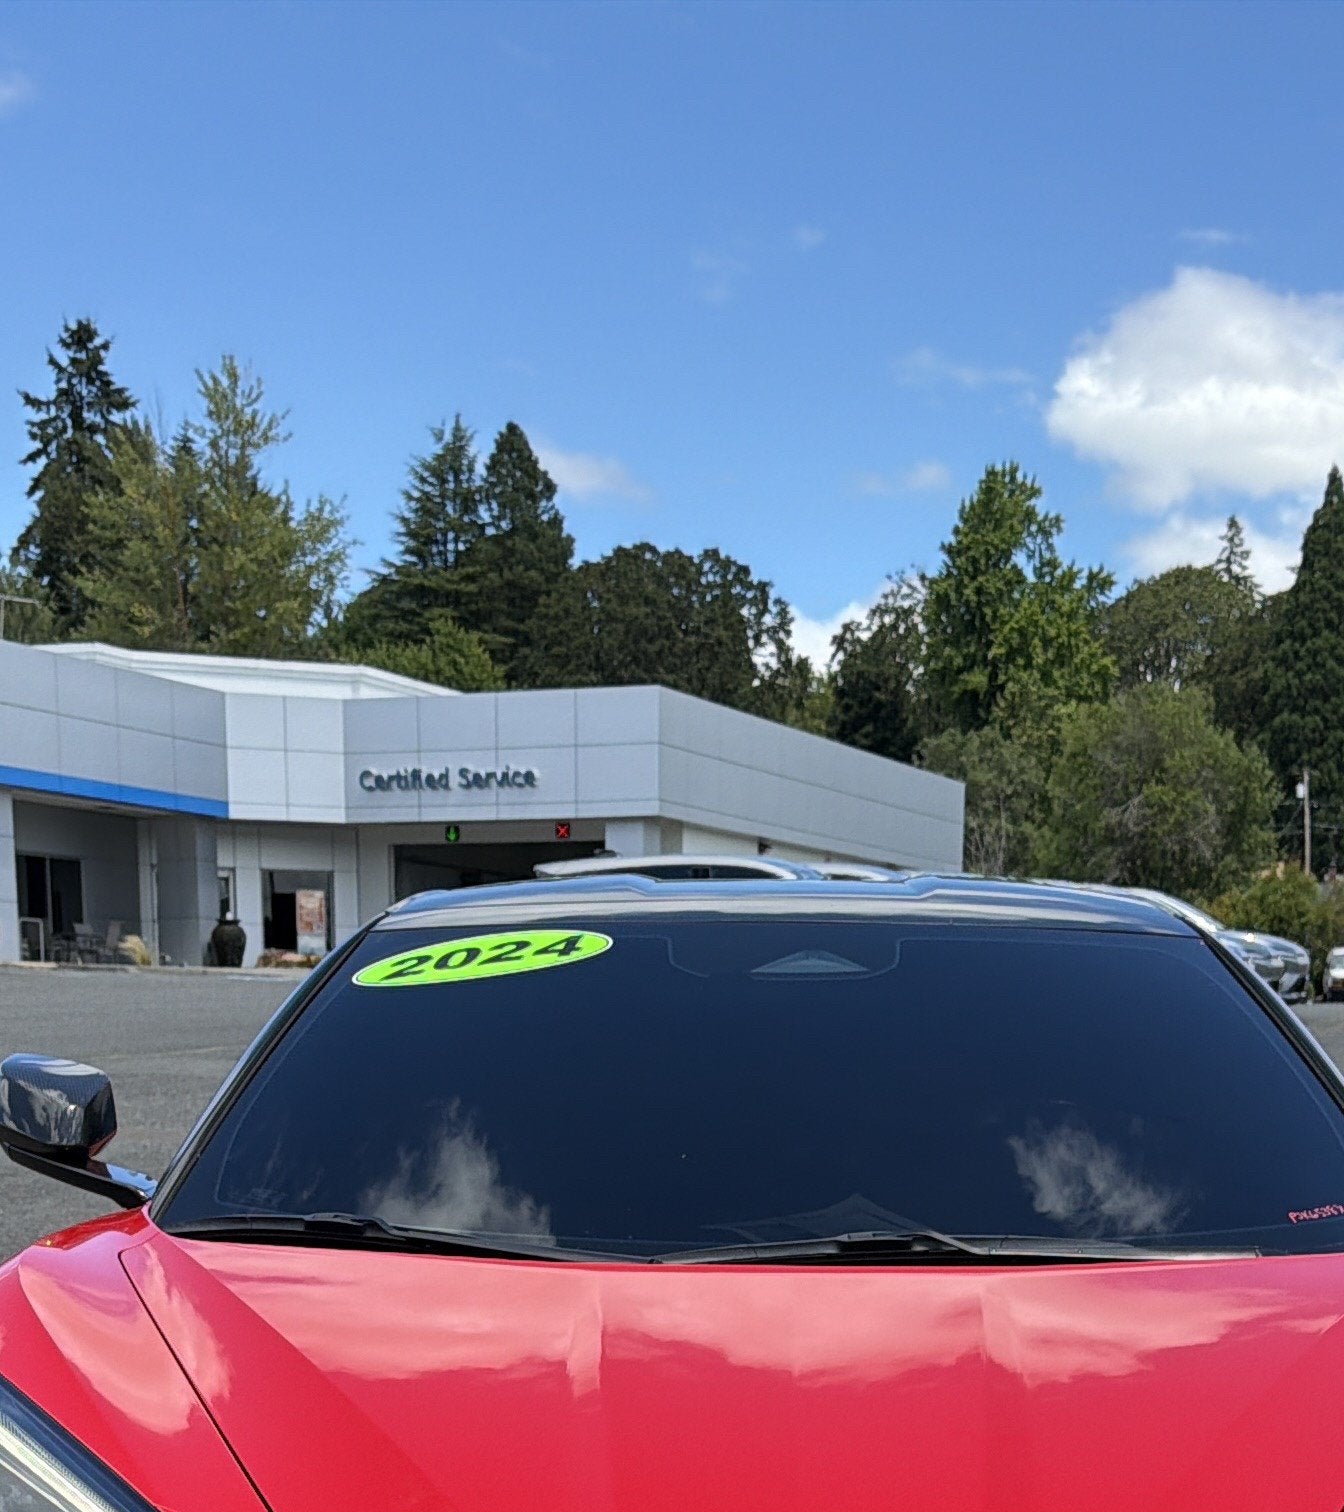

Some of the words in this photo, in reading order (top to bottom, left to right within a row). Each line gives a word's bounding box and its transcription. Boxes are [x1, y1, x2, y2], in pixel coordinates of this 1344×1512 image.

[359, 767, 451, 792] Certified
[458, 765, 537, 790] Service
[380, 934, 585, 982] 2024
